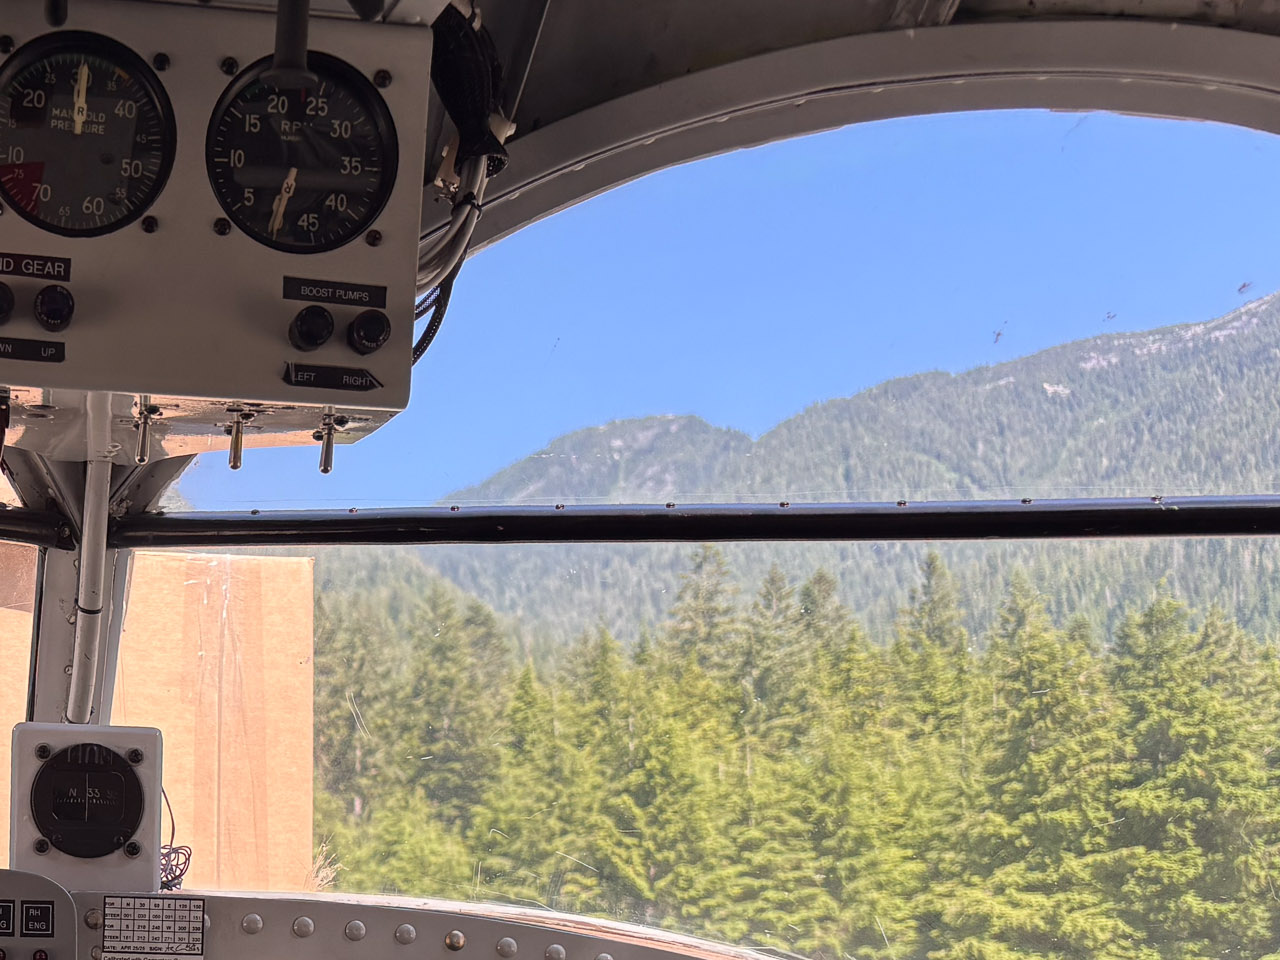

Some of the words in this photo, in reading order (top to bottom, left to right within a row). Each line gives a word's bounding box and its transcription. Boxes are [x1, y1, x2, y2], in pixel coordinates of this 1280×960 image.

[23, 89, 45, 108] 20
[268, 96, 288, 113] 20
[306, 97, 328, 116] 25
[115, 100, 135, 118] 40
[245, 115, 261, 132] 15
[330, 120, 351, 138] 30
[8, 146, 24, 164] 10
[231, 150, 245, 167] 10
[121, 159, 142, 177] 50
[341, 157, 361, 175] 35
[32, 183, 51, 201] 70
[244, 189, 254, 206] 5
[82, 197, 104, 215] 60
[325, 194, 347, 211] 40
[298, 215, 319, 231] 45
[22, 260, 64, 276] GEAR
[301, 286, 333, 297] BOOST
[336, 290, 369, 301] PUMPS
[41, 348, 55, 357] UP
[293, 371, 316, 381] LEFT
[343, 376, 370, 386] RIGHT
[28, 922, 46, 930] ENG
